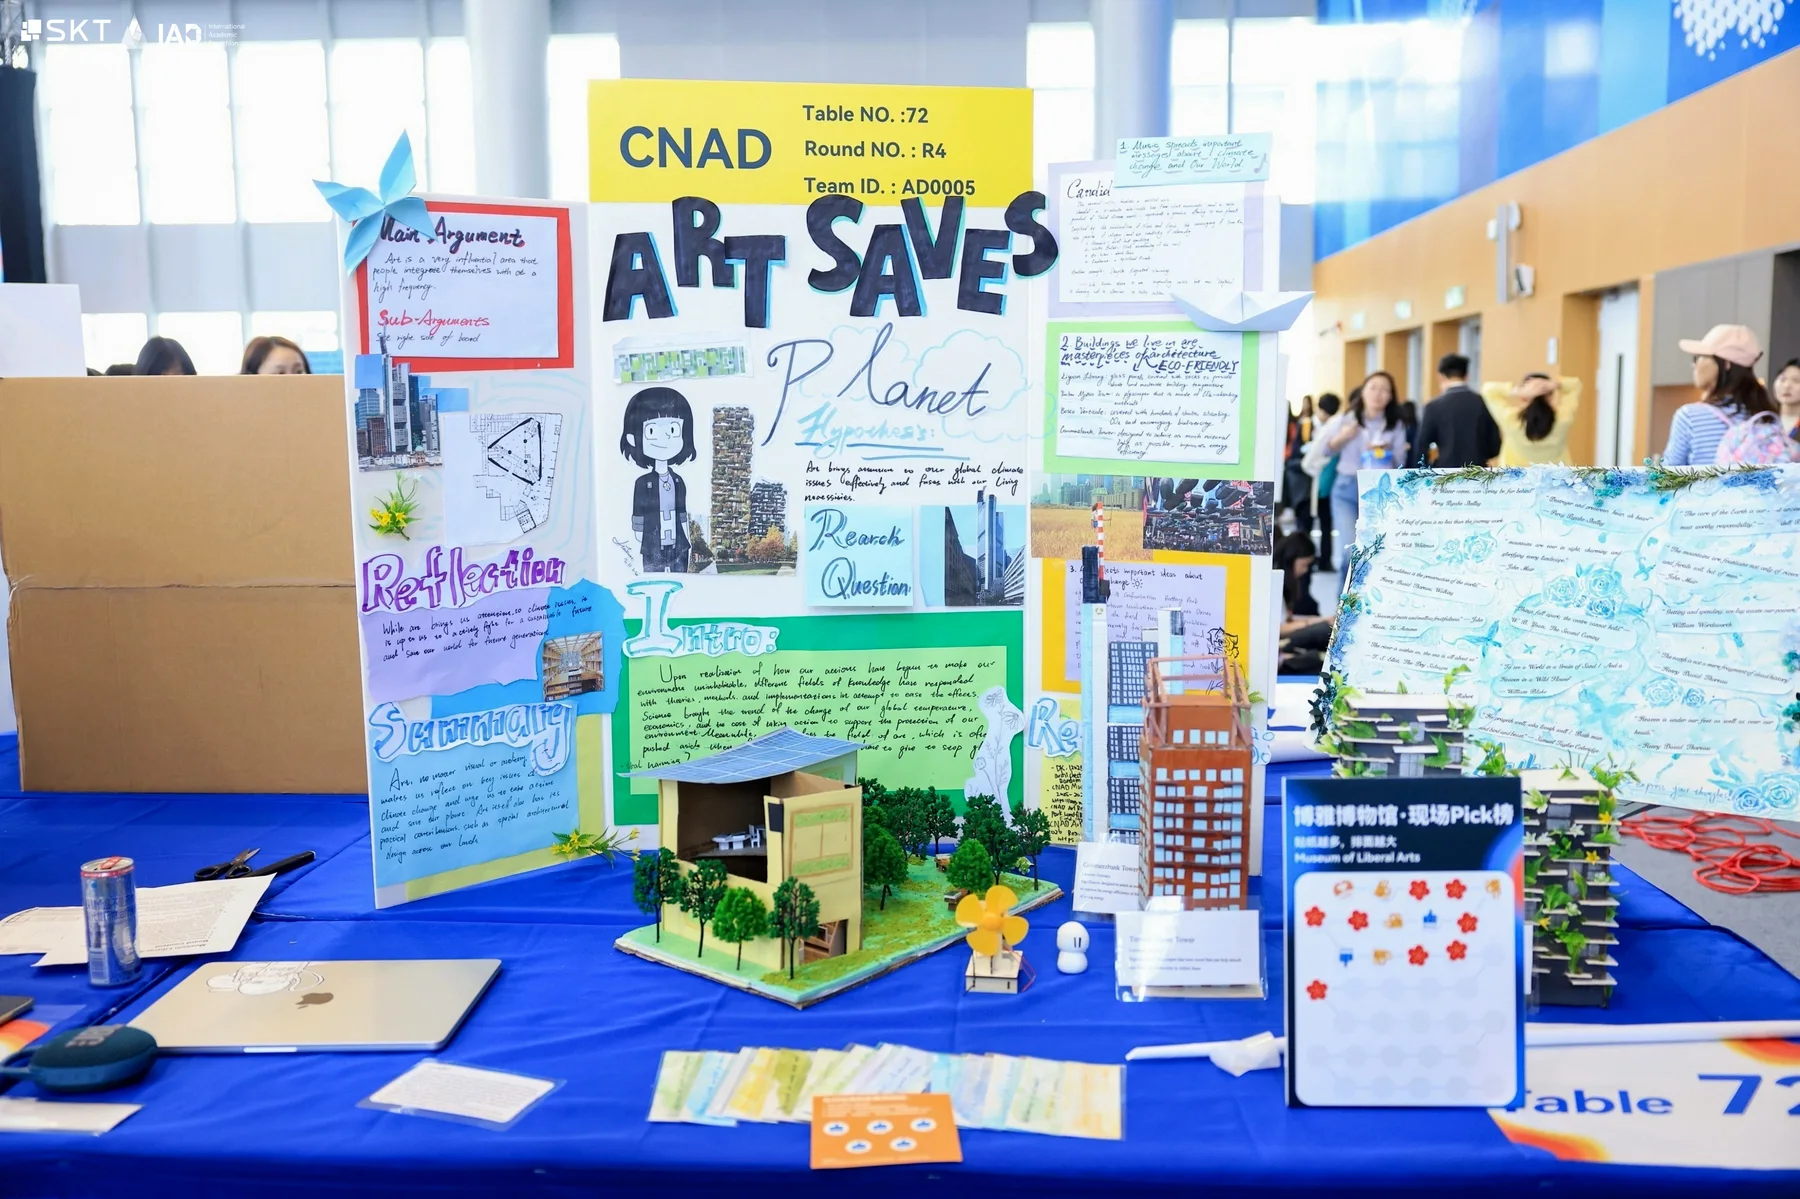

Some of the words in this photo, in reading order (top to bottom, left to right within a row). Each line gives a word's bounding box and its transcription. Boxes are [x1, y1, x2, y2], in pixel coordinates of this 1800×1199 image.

[802, 105, 854, 122] Table
[860, 106, 895, 122] NO.
[620, 126, 772, 169] CNAD
[804, 140, 865, 157] Round
[871, 142, 905, 158] NO.
[922, 143, 946, 159] R4
[1132, 140, 1160, 150] Music
[1166, 140, 1198, 156] spreads
[1203, 140, 1242, 156] important
[804, 178, 855, 194] Team
[861, 178, 886, 194] ID.
[902, 180, 976, 196] AD0005
[427, 216, 526, 254] Argument
[602, 196, 787, 329] ART
[806, 190, 1060, 318] SAVES
[377, 309, 490, 336] Sub-Arguments
[1075, 336, 1120, 354] Buildings
[1126, 338, 1138, 347] we
[1143, 335, 1162, 348] live
[1181, 339, 1198, 348] are
[1158, 360, 1240, 372] ECO-FRIENDLY
[761, 322, 992, 446] Planet
[361, 546, 566, 612] Reflection
[821, 556, 912, 600] Question
[1124, 568, 1156, 581] important
[1160, 568, 1176, 578] ideas
[1184, 570, 1203, 580] about
[624, 580, 778, 655] Intro:
[368, 702, 572, 771] Summary
[1294, 852, 1340, 864] Museum
[1342, 851, 1356, 864] of
[1356, 851, 1395, 864] Liberal
[1396, 852, 1420, 863] Arts
